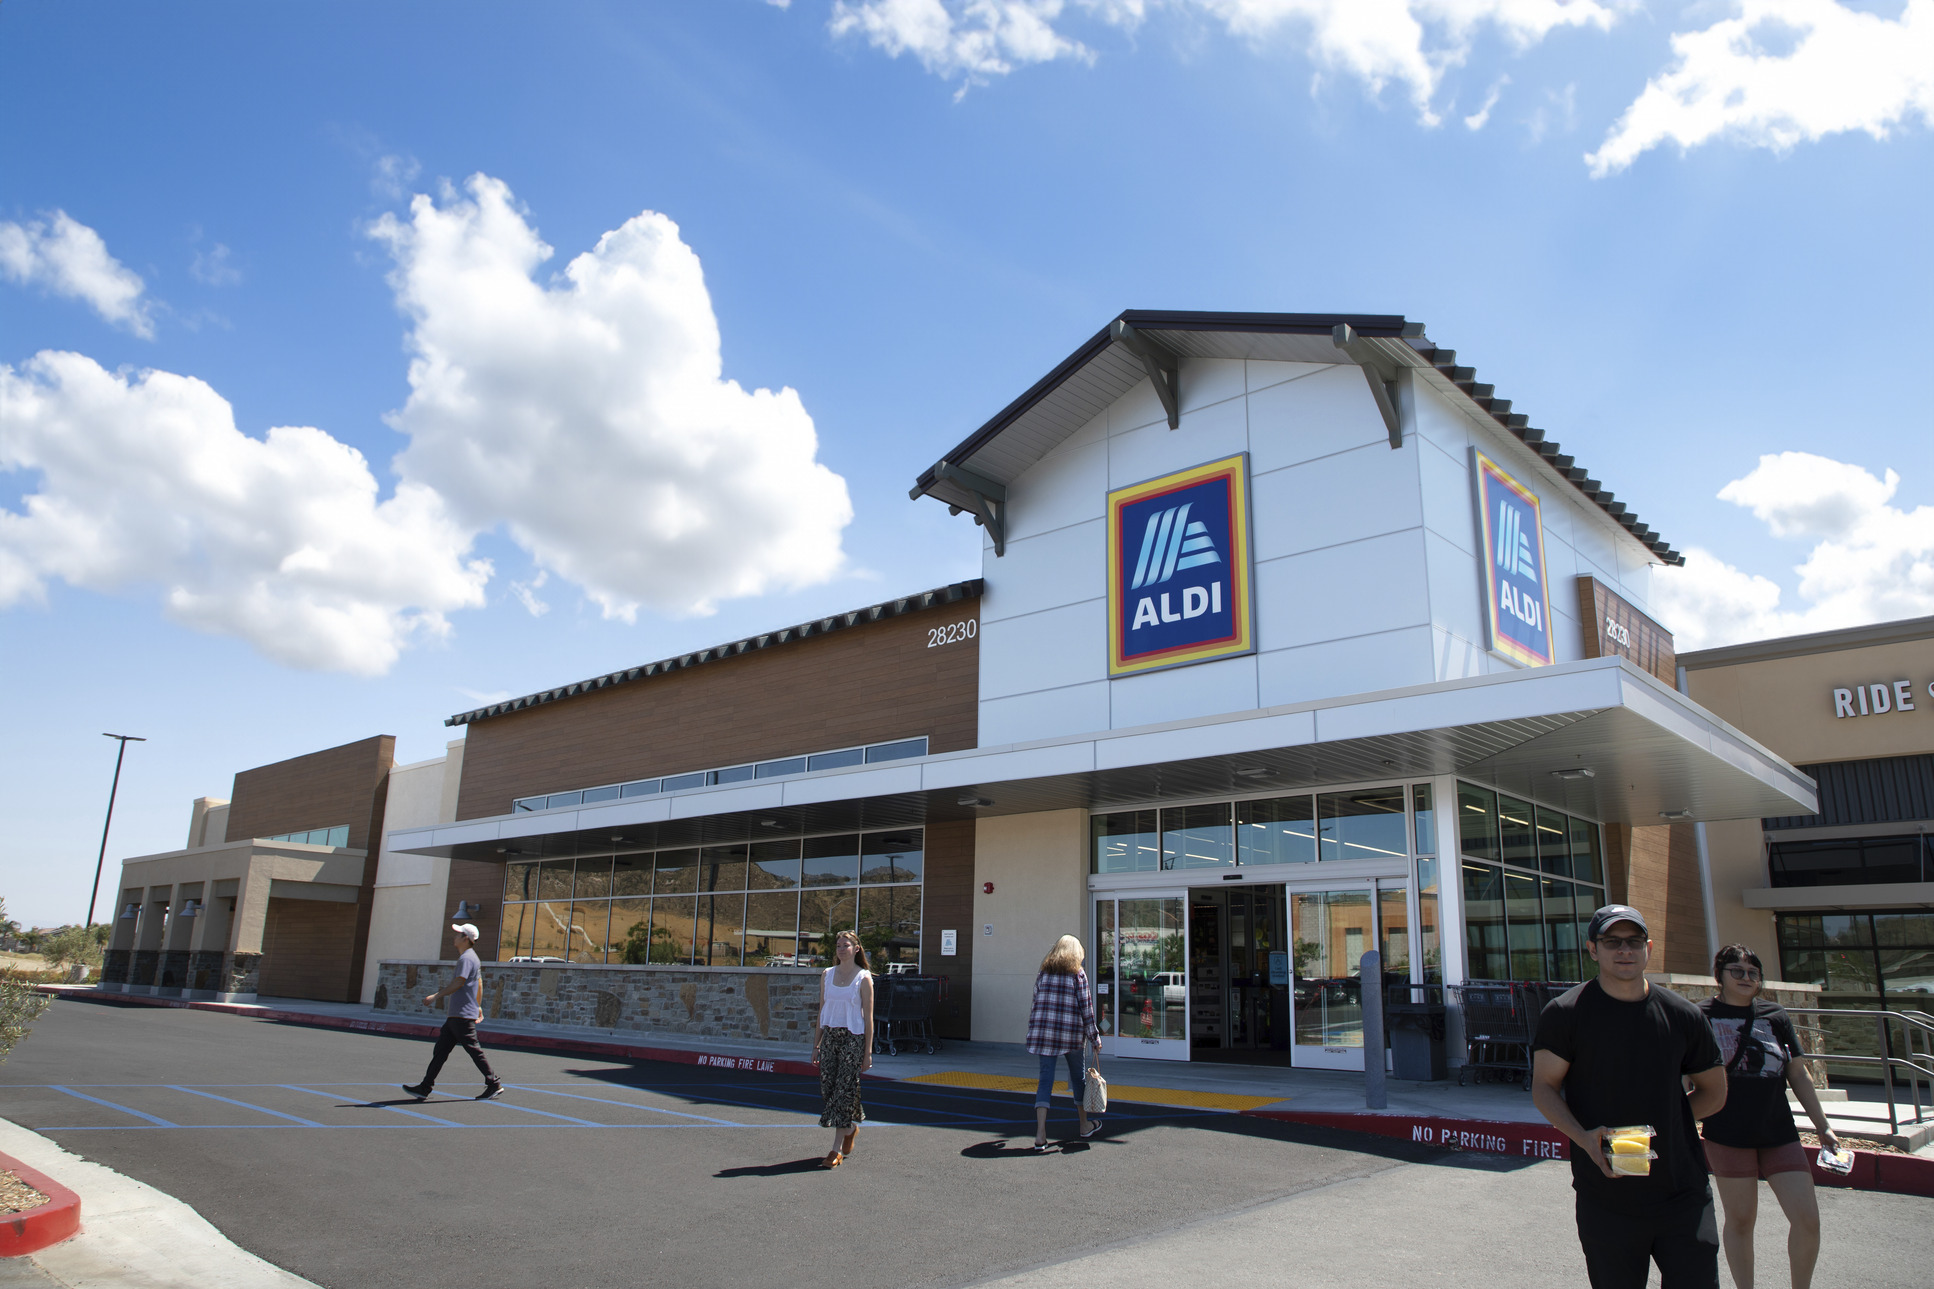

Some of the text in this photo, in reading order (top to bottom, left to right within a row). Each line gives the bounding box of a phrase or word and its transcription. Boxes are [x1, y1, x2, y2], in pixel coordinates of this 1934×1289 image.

[1132, 581, 1222, 630] ALDI
[1501, 579, 1543, 632] ALDI
[927, 618, 977, 648] 28230
[1605, 616, 1631, 649] 28230
[1833, 680, 1915, 718] RIDE
[698, 1055, 775, 1073] NO PARKING FIRE LANE
[1412, 1125, 1433, 1142] NO
[1523, 1139, 1562, 1159] FIRE
